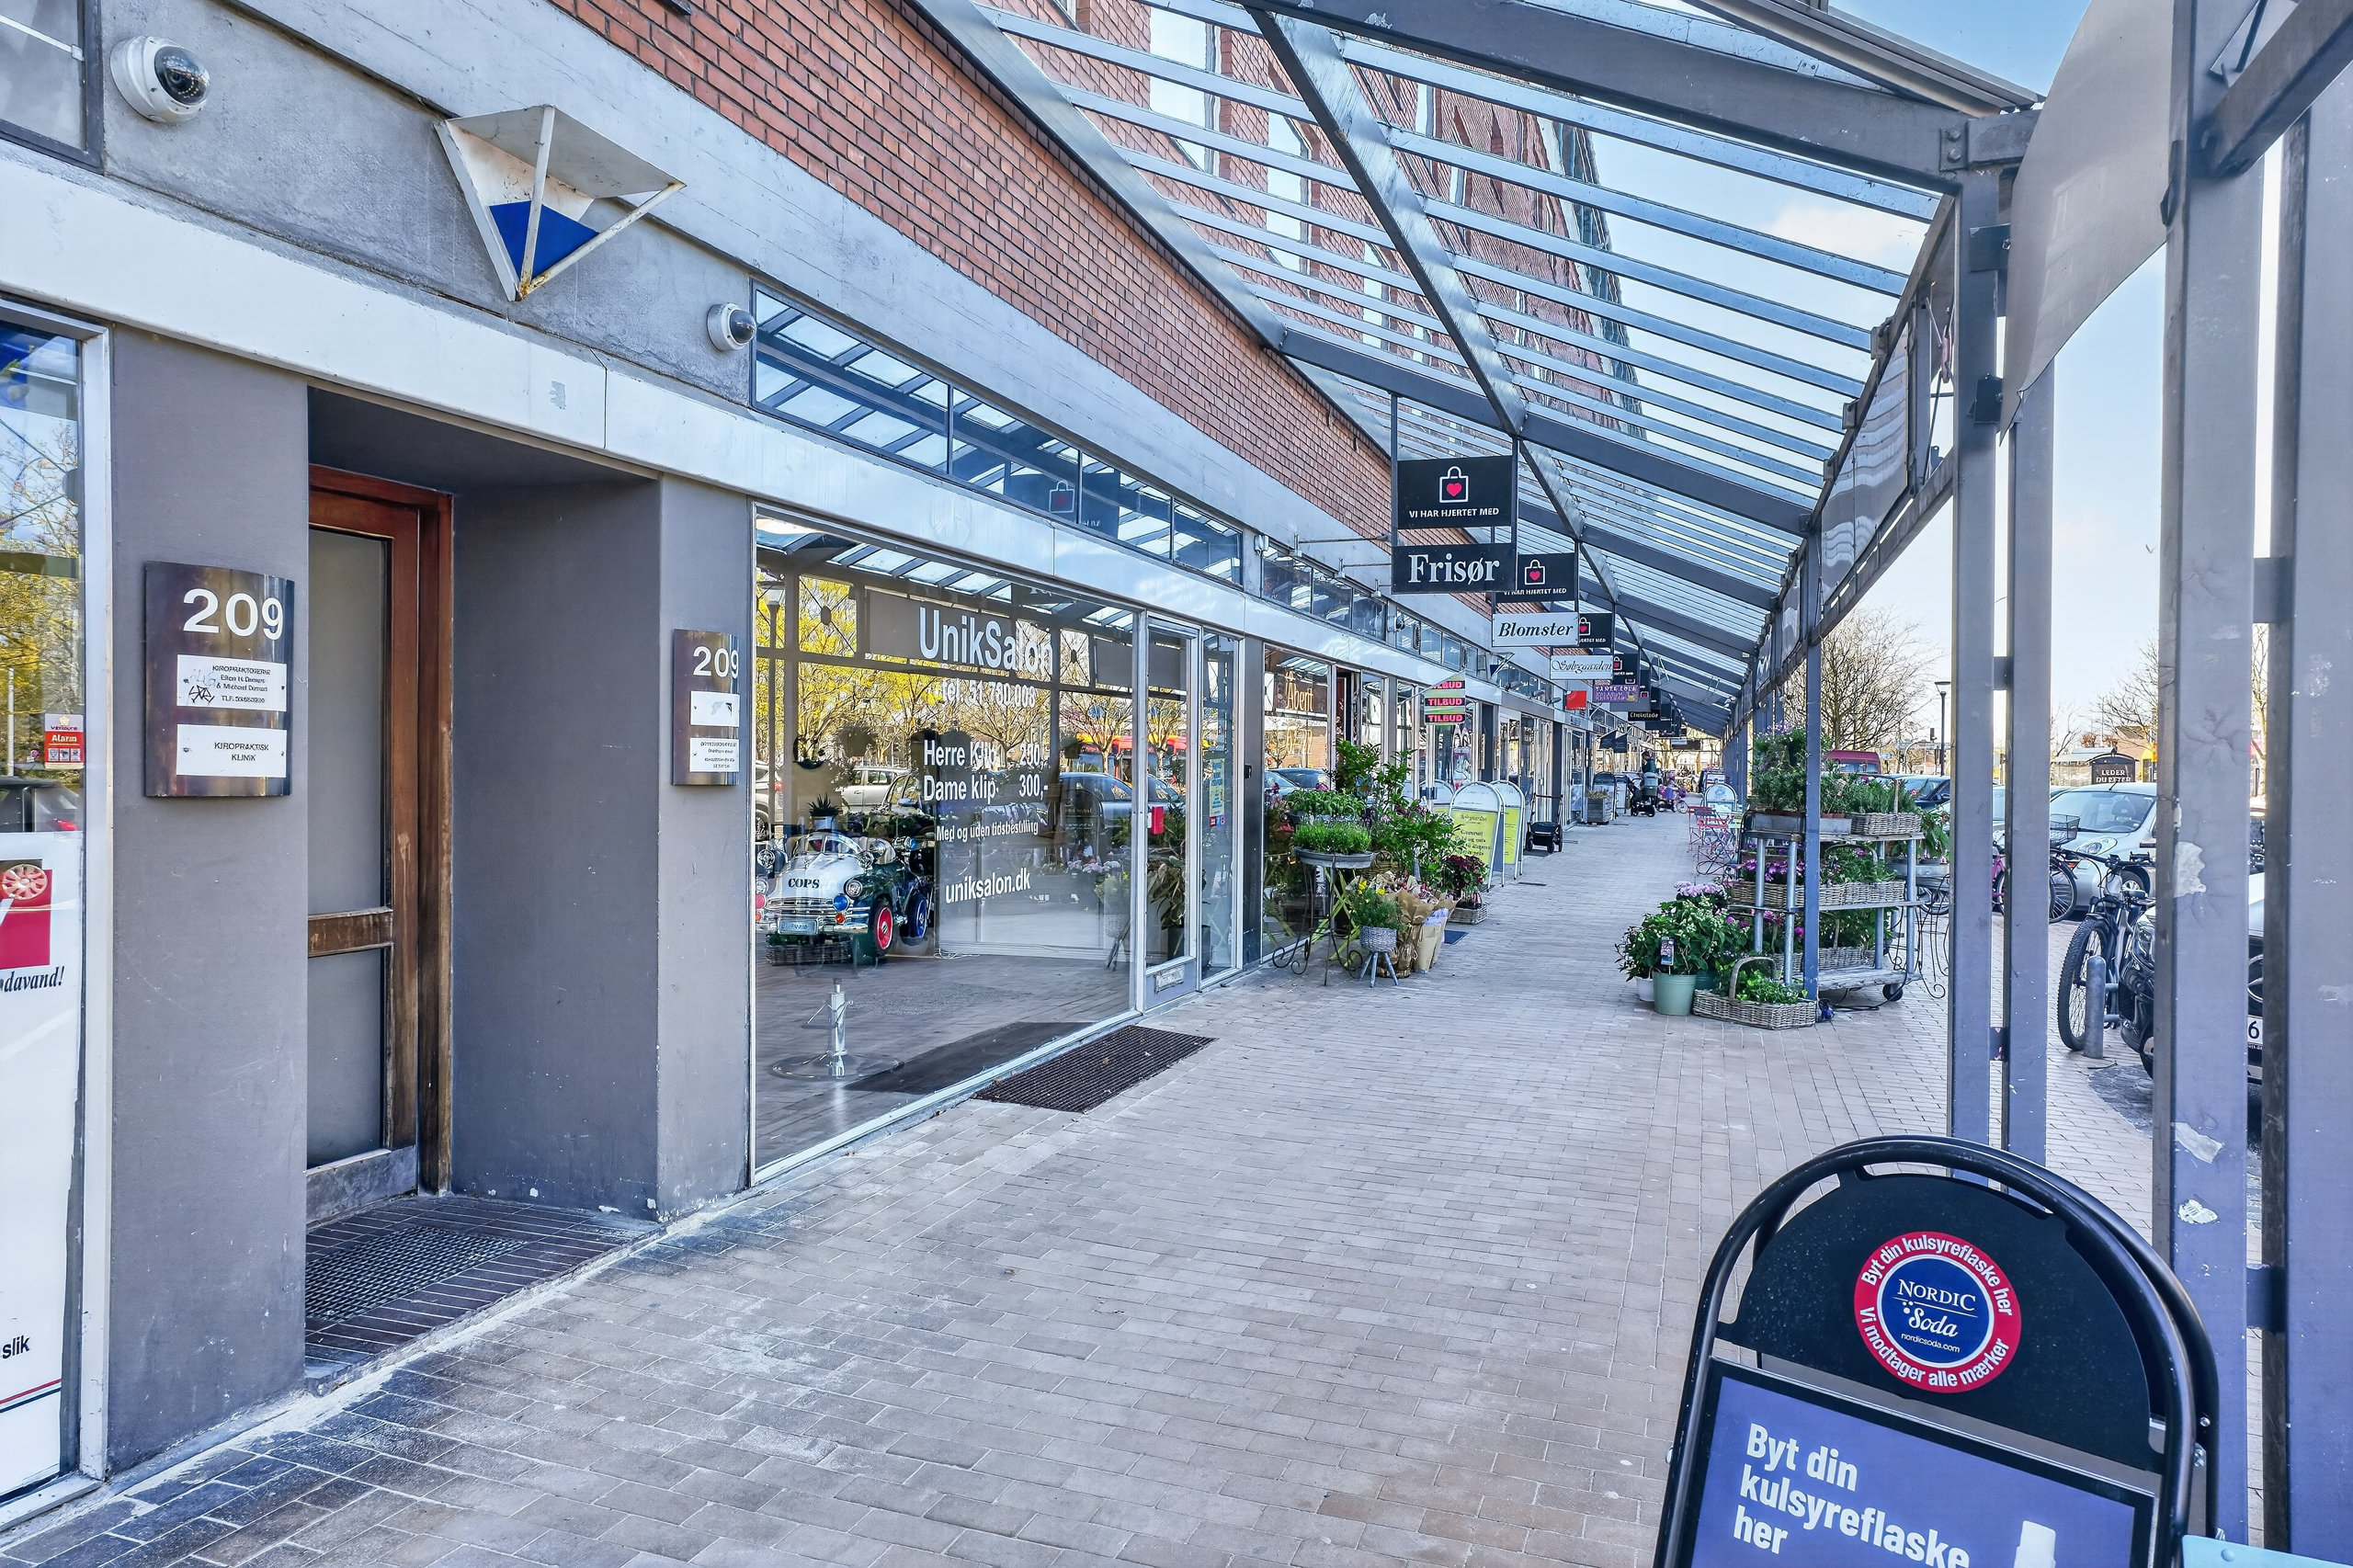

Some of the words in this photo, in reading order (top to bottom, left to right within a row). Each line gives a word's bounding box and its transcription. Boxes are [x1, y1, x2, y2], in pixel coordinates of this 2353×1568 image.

[1409, 510, 1418, 518] VI
[1420, 509, 1439, 517] HAR
[1441, 508, 1478, 517] HJERTET
[1479, 507, 1499, 516] MED
[1408, 552, 1500, 585] Frisør
[183, 588, 283, 641] 209
[1498, 620, 1574, 638] Blomster
[919, 607, 1053, 676] UnikSalon
[693, 646, 739, 679] 209
[1434, 681, 1462, 689] LBUD
[1427, 698, 1463, 706] TILBUD
[1427, 714, 1463, 722] TILBUD
[51, 733, 77, 742] Alarm
[924, 739, 966, 767] Herre
[924, 775, 967, 801] Dame
[971, 774, 996, 804] klip
[1018, 774, 1049, 801] 300,-
[937, 825, 955, 841] Med
[957, 826, 968, 842] og
[970, 822, 991, 838] uden
[788, 878, 820, 889] COPS
[945, 867, 1031, 903] uniksalon.dk
[1860, 1259, 1885, 1286] Byt
[1880, 1244, 1904, 1264] din
[1902, 1234, 2001, 1287] kulsyreflaske
[1993, 1287, 2013, 1316] her
[1896, 1278, 1976, 1312] NORDIC
[1859, 1306, 1878, 1324] Vi
[1908, 1307, 1959, 1337] Soda
[1864, 1324, 1927, 1382] modtager
[1901, 1333, 1961, 1353] nordicsoda.com
[1959, 1337, 2010, 1385] mærker
[1928, 1370, 1958, 1387] alle
[1746, 1422, 1800, 1471] Byt
[1806, 1445, 1858, 1492] din
[1733, 1505, 1789, 1555] her
[1740, 1463, 1970, 1568] kulsyreflaske
